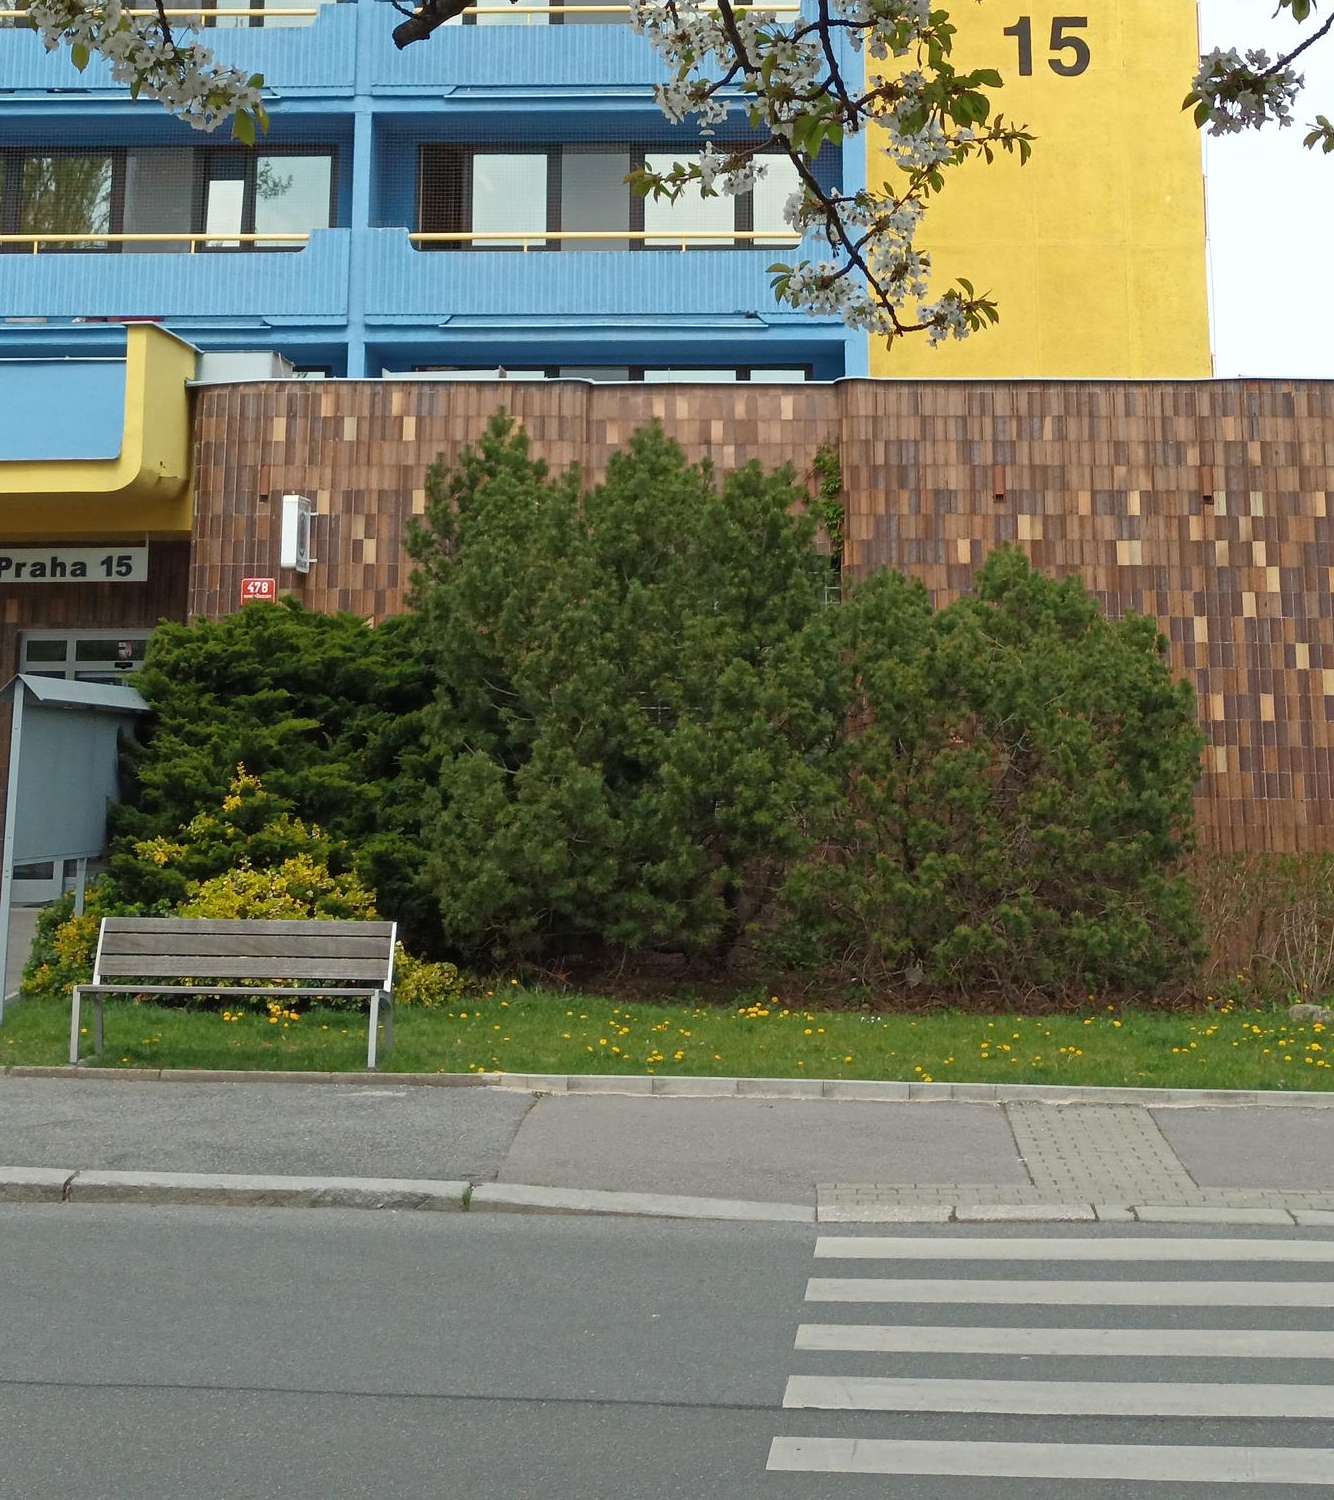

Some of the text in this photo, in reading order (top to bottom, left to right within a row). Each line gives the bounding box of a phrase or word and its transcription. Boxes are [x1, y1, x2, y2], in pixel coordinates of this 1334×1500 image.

[1003, 16, 1091, 77] 15
[100, 555, 133, 578] 15
[247, 581, 269, 594] 478
